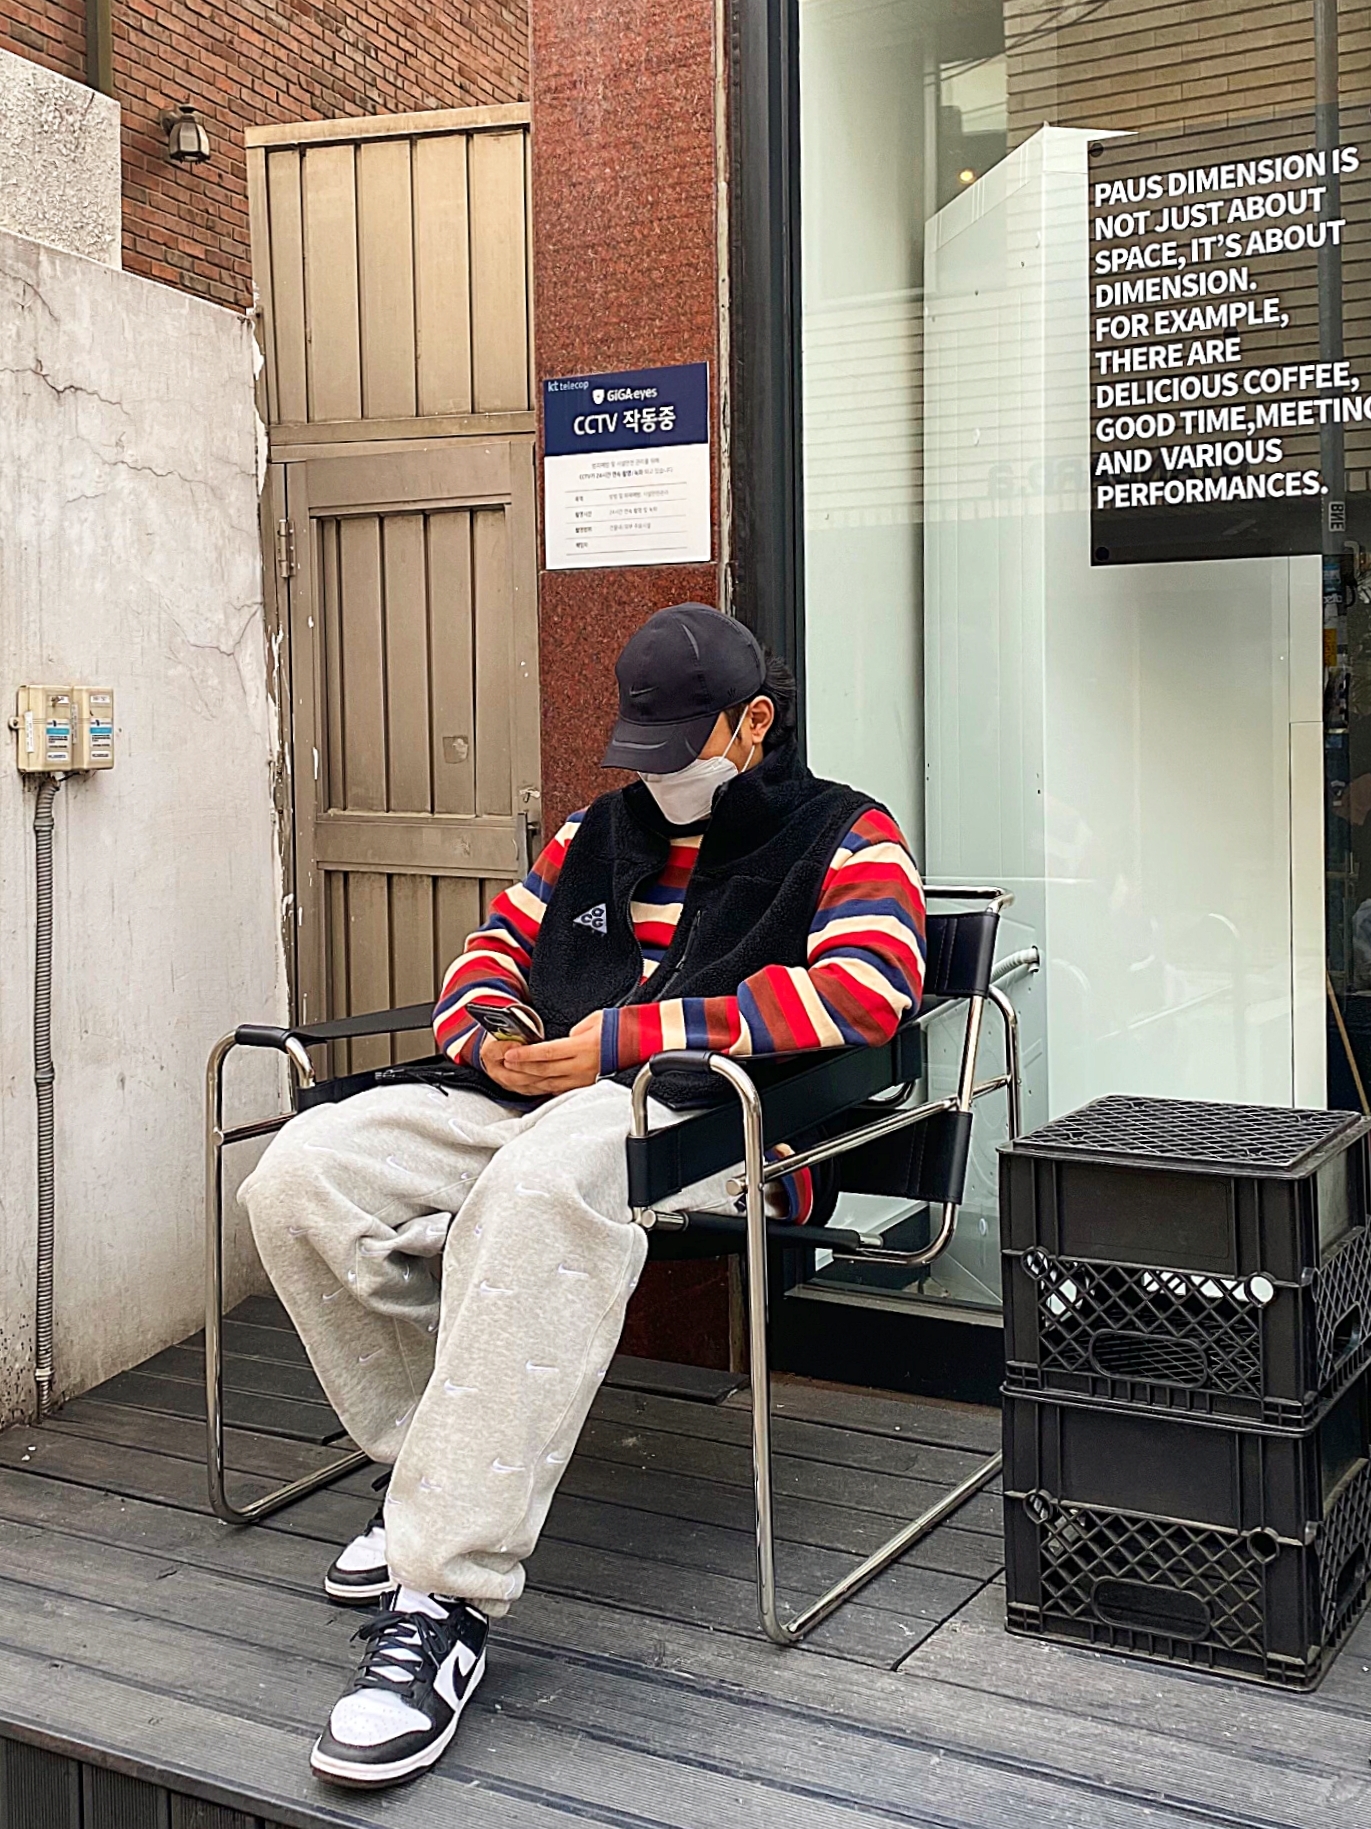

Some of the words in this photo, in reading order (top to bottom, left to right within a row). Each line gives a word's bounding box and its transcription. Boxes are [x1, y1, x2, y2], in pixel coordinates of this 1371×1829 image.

[1095, 174, 1165, 208] PAUS
[1168, 155, 1326, 197] DIMENSION
[1332, 146, 1359, 174] IS
[1095, 210, 1151, 241] NOT
[1154, 200, 1224, 233] JUST
[1226, 186, 1327, 224] ABOUT
[1095, 241, 1187, 275] SPACE,
[1244, 219, 1346, 256] ABOUT
[1096, 266, 1257, 309] DIMENSION.
[1096, 314, 1149, 342] FOR
[1154, 297, 1290, 336] EXAMPLE,
[1096, 344, 1183, 375] THERE
[1186, 336, 1242, 366] ARE
[548, 381, 559, 392] kt
[559, 381, 589, 391] telecop
[1096, 372, 1239, 409] DELICIOUS
[1243, 361, 1360, 395] COFFEE,
[573, 412, 618, 436] CCTV
[622, 405, 677, 433] 작동중
[1096, 412, 1176, 442] GOOD
[1095, 449, 1152, 476] AND
[1160, 438, 1283, 471] VARIOUS
[1097, 470, 1329, 509] PERFORMANCES.
